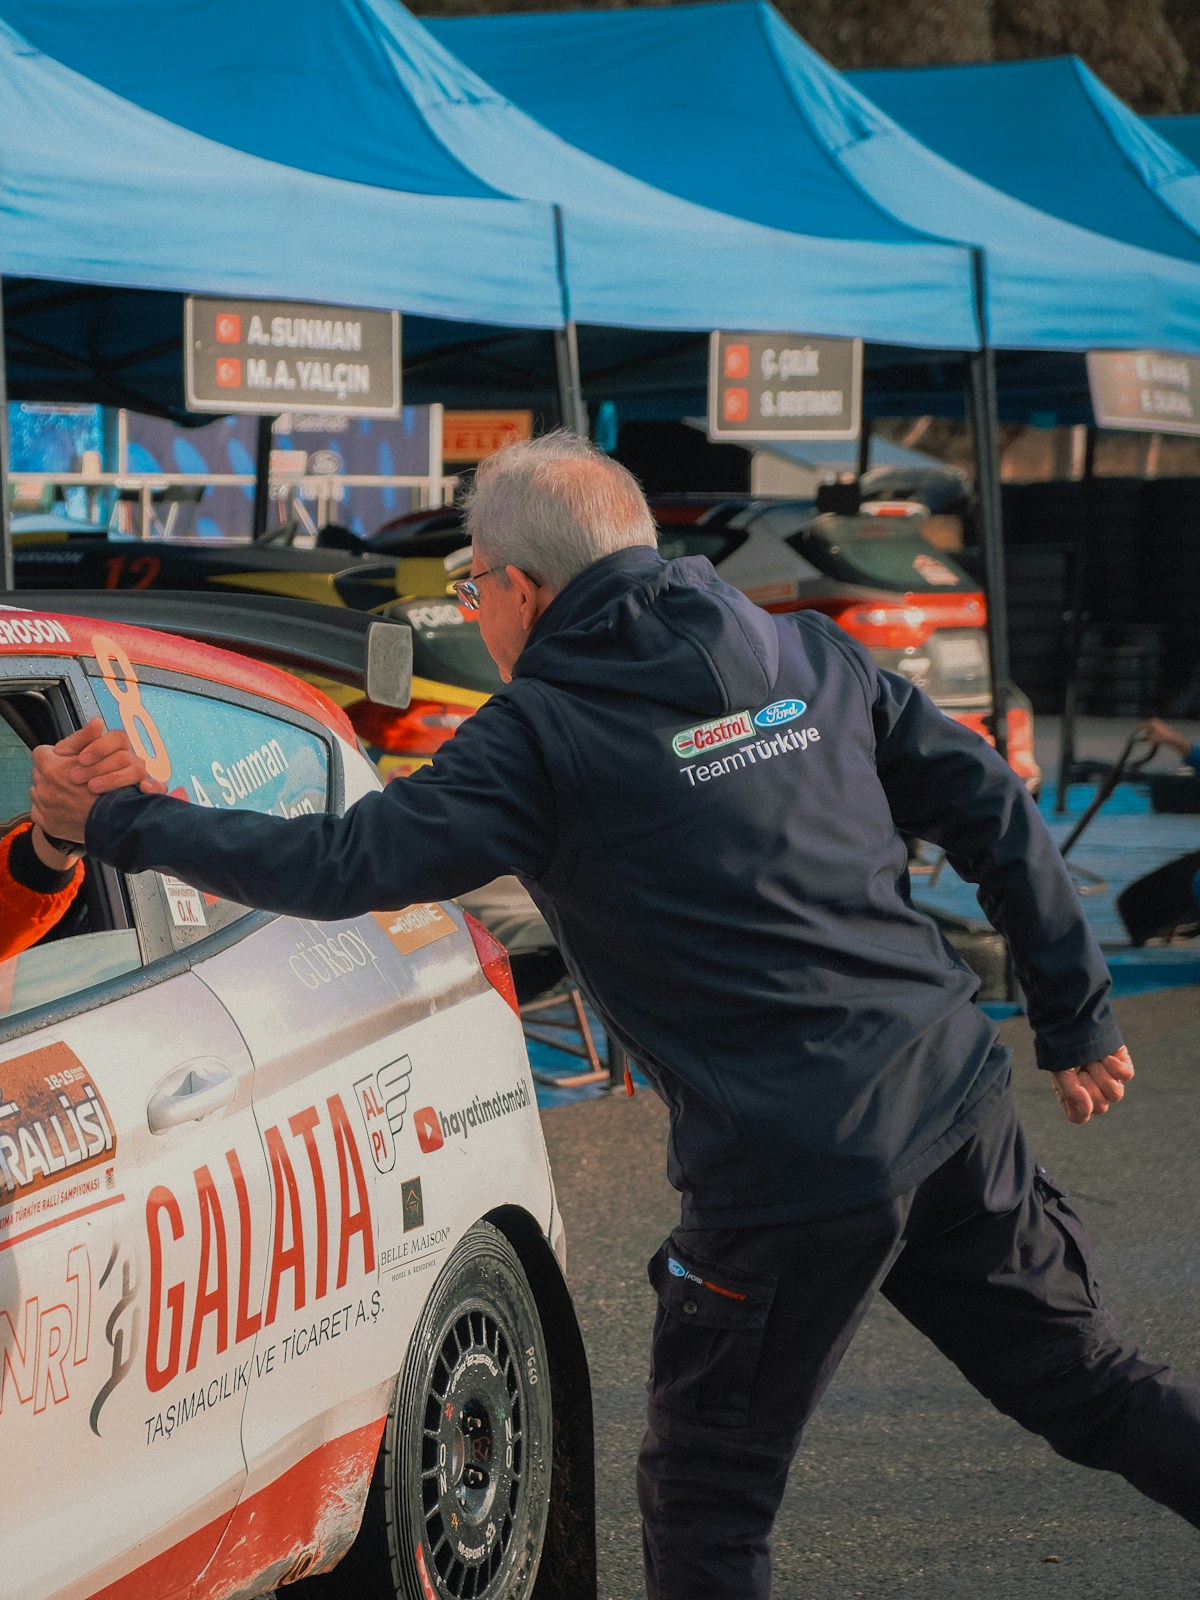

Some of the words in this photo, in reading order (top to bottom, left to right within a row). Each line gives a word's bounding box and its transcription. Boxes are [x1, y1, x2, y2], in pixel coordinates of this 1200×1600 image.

[271, 316, 362, 352] SUNMAN
[91, 634, 173, 783] 8
[693, 715, 751, 750] Castrol
[211, 738, 290, 806] Sunman
[288, 925, 380, 991] GÜRSOY
[361, 1086, 385, 1121] AL
[371, 1129, 388, 1164] PI
[144, 1093, 377, 1393] GALATA
[381, 1243, 409, 1266] BELLE
[144, 1359, 251, 1447] TAŞIMACILIK
[255, 1344, 277, 1379] VE
[281, 1303, 353, 1365] TİCARET
[354, 1289, 386, 1328] A.Ş.
